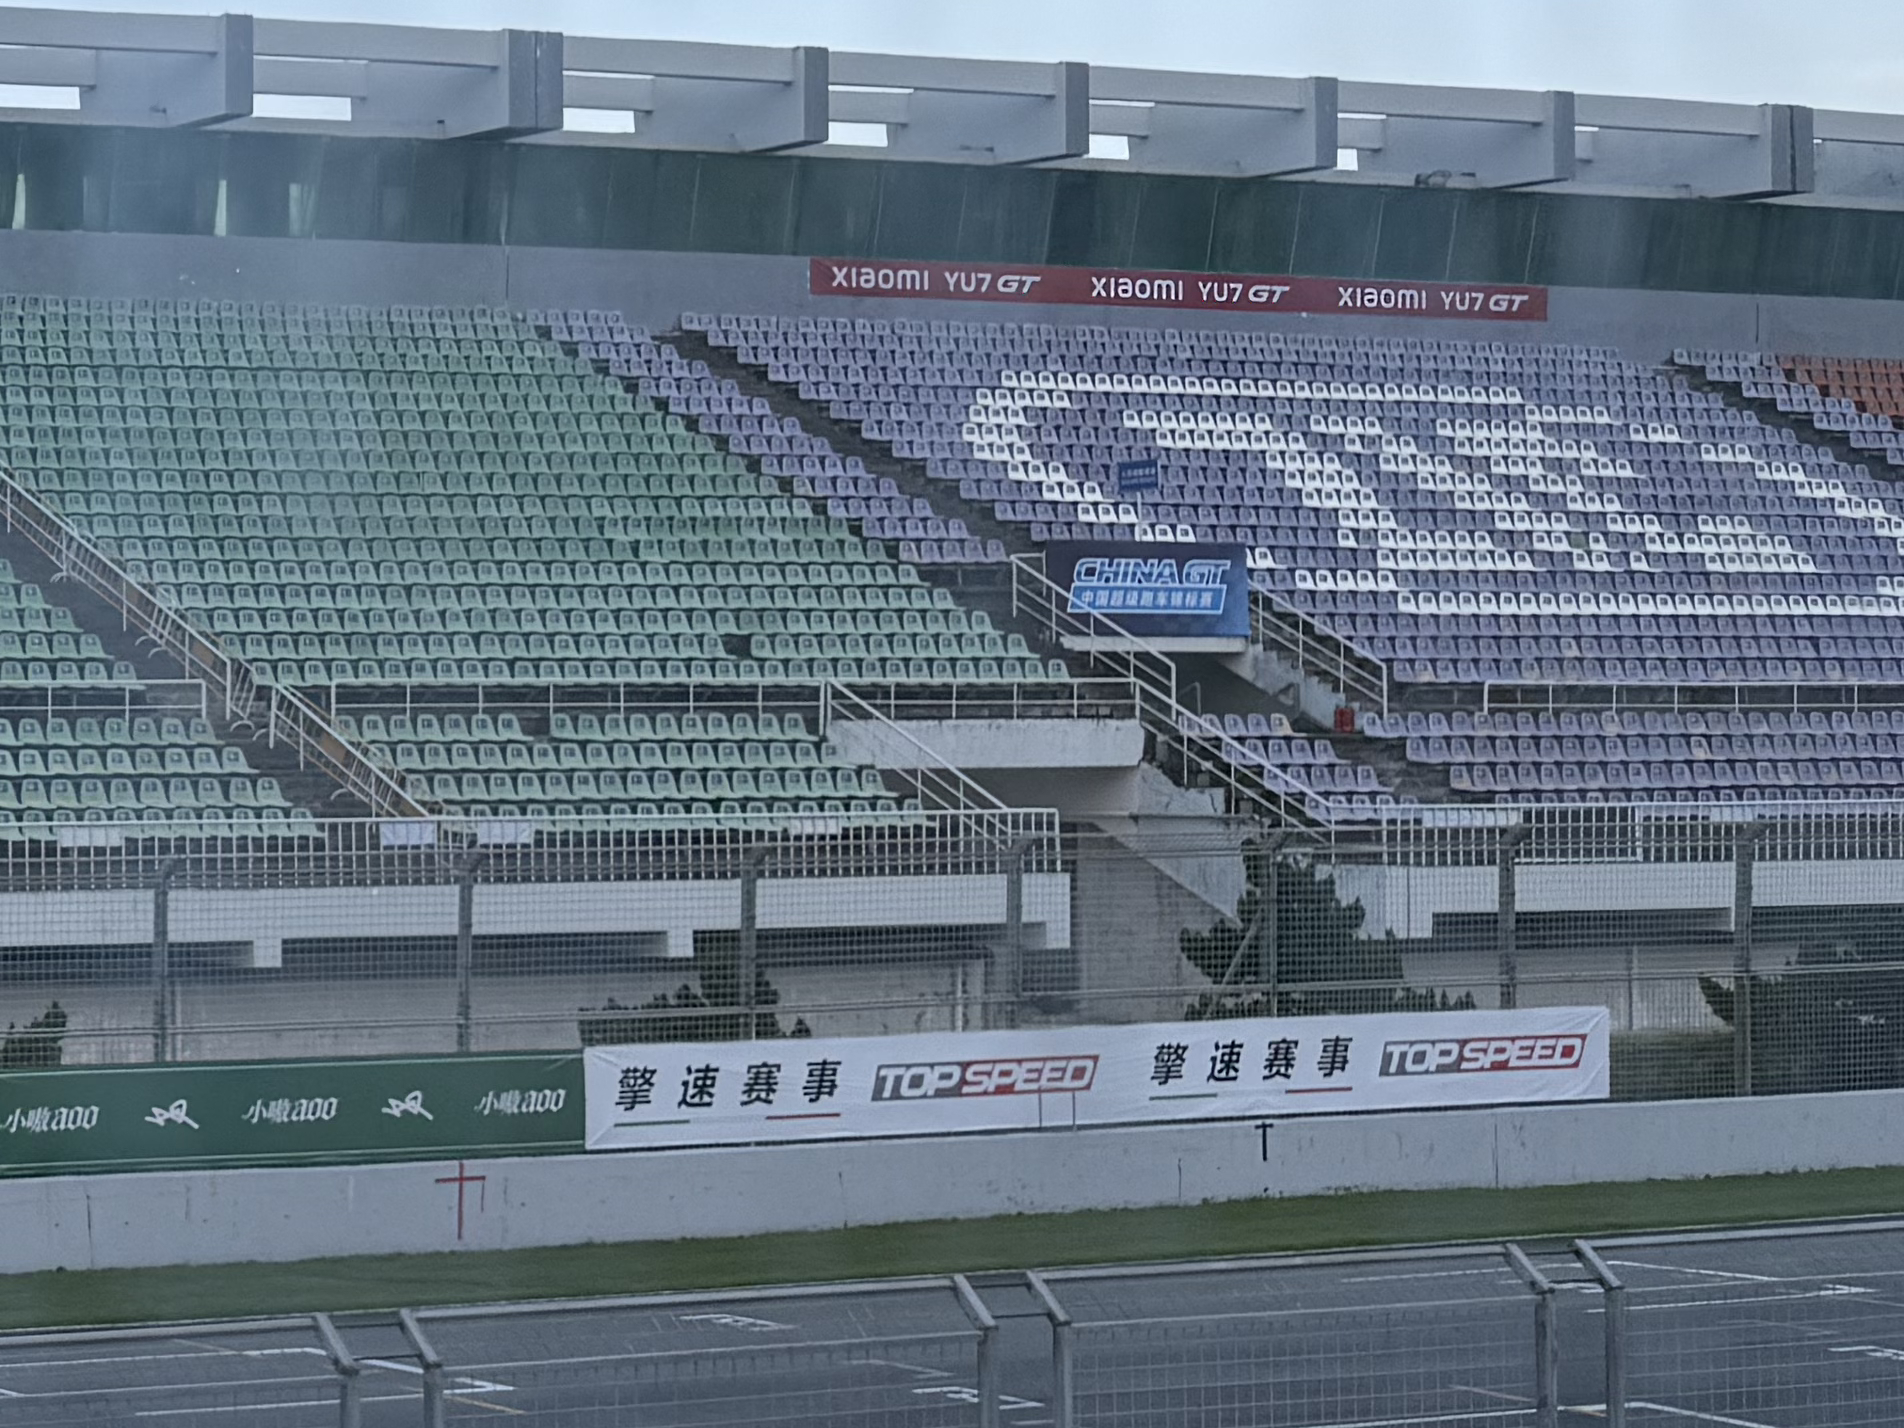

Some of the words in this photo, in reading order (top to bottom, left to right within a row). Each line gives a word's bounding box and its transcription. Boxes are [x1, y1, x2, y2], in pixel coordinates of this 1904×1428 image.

[944, 271, 992, 293] YU7
[996, 274, 1042, 294] GT
[1198, 280, 1243, 303] YU7
[1247, 284, 1291, 303] GT
[1440, 290, 1485, 312] YU7
[1488, 294, 1530, 312] GT
[1073, 557, 1180, 585] CHINA
[1182, 559, 1232, 586] GT
[1149, 1034, 1355, 1086] 擎速赛事
[614, 1058, 843, 1112] 擎速赛事
